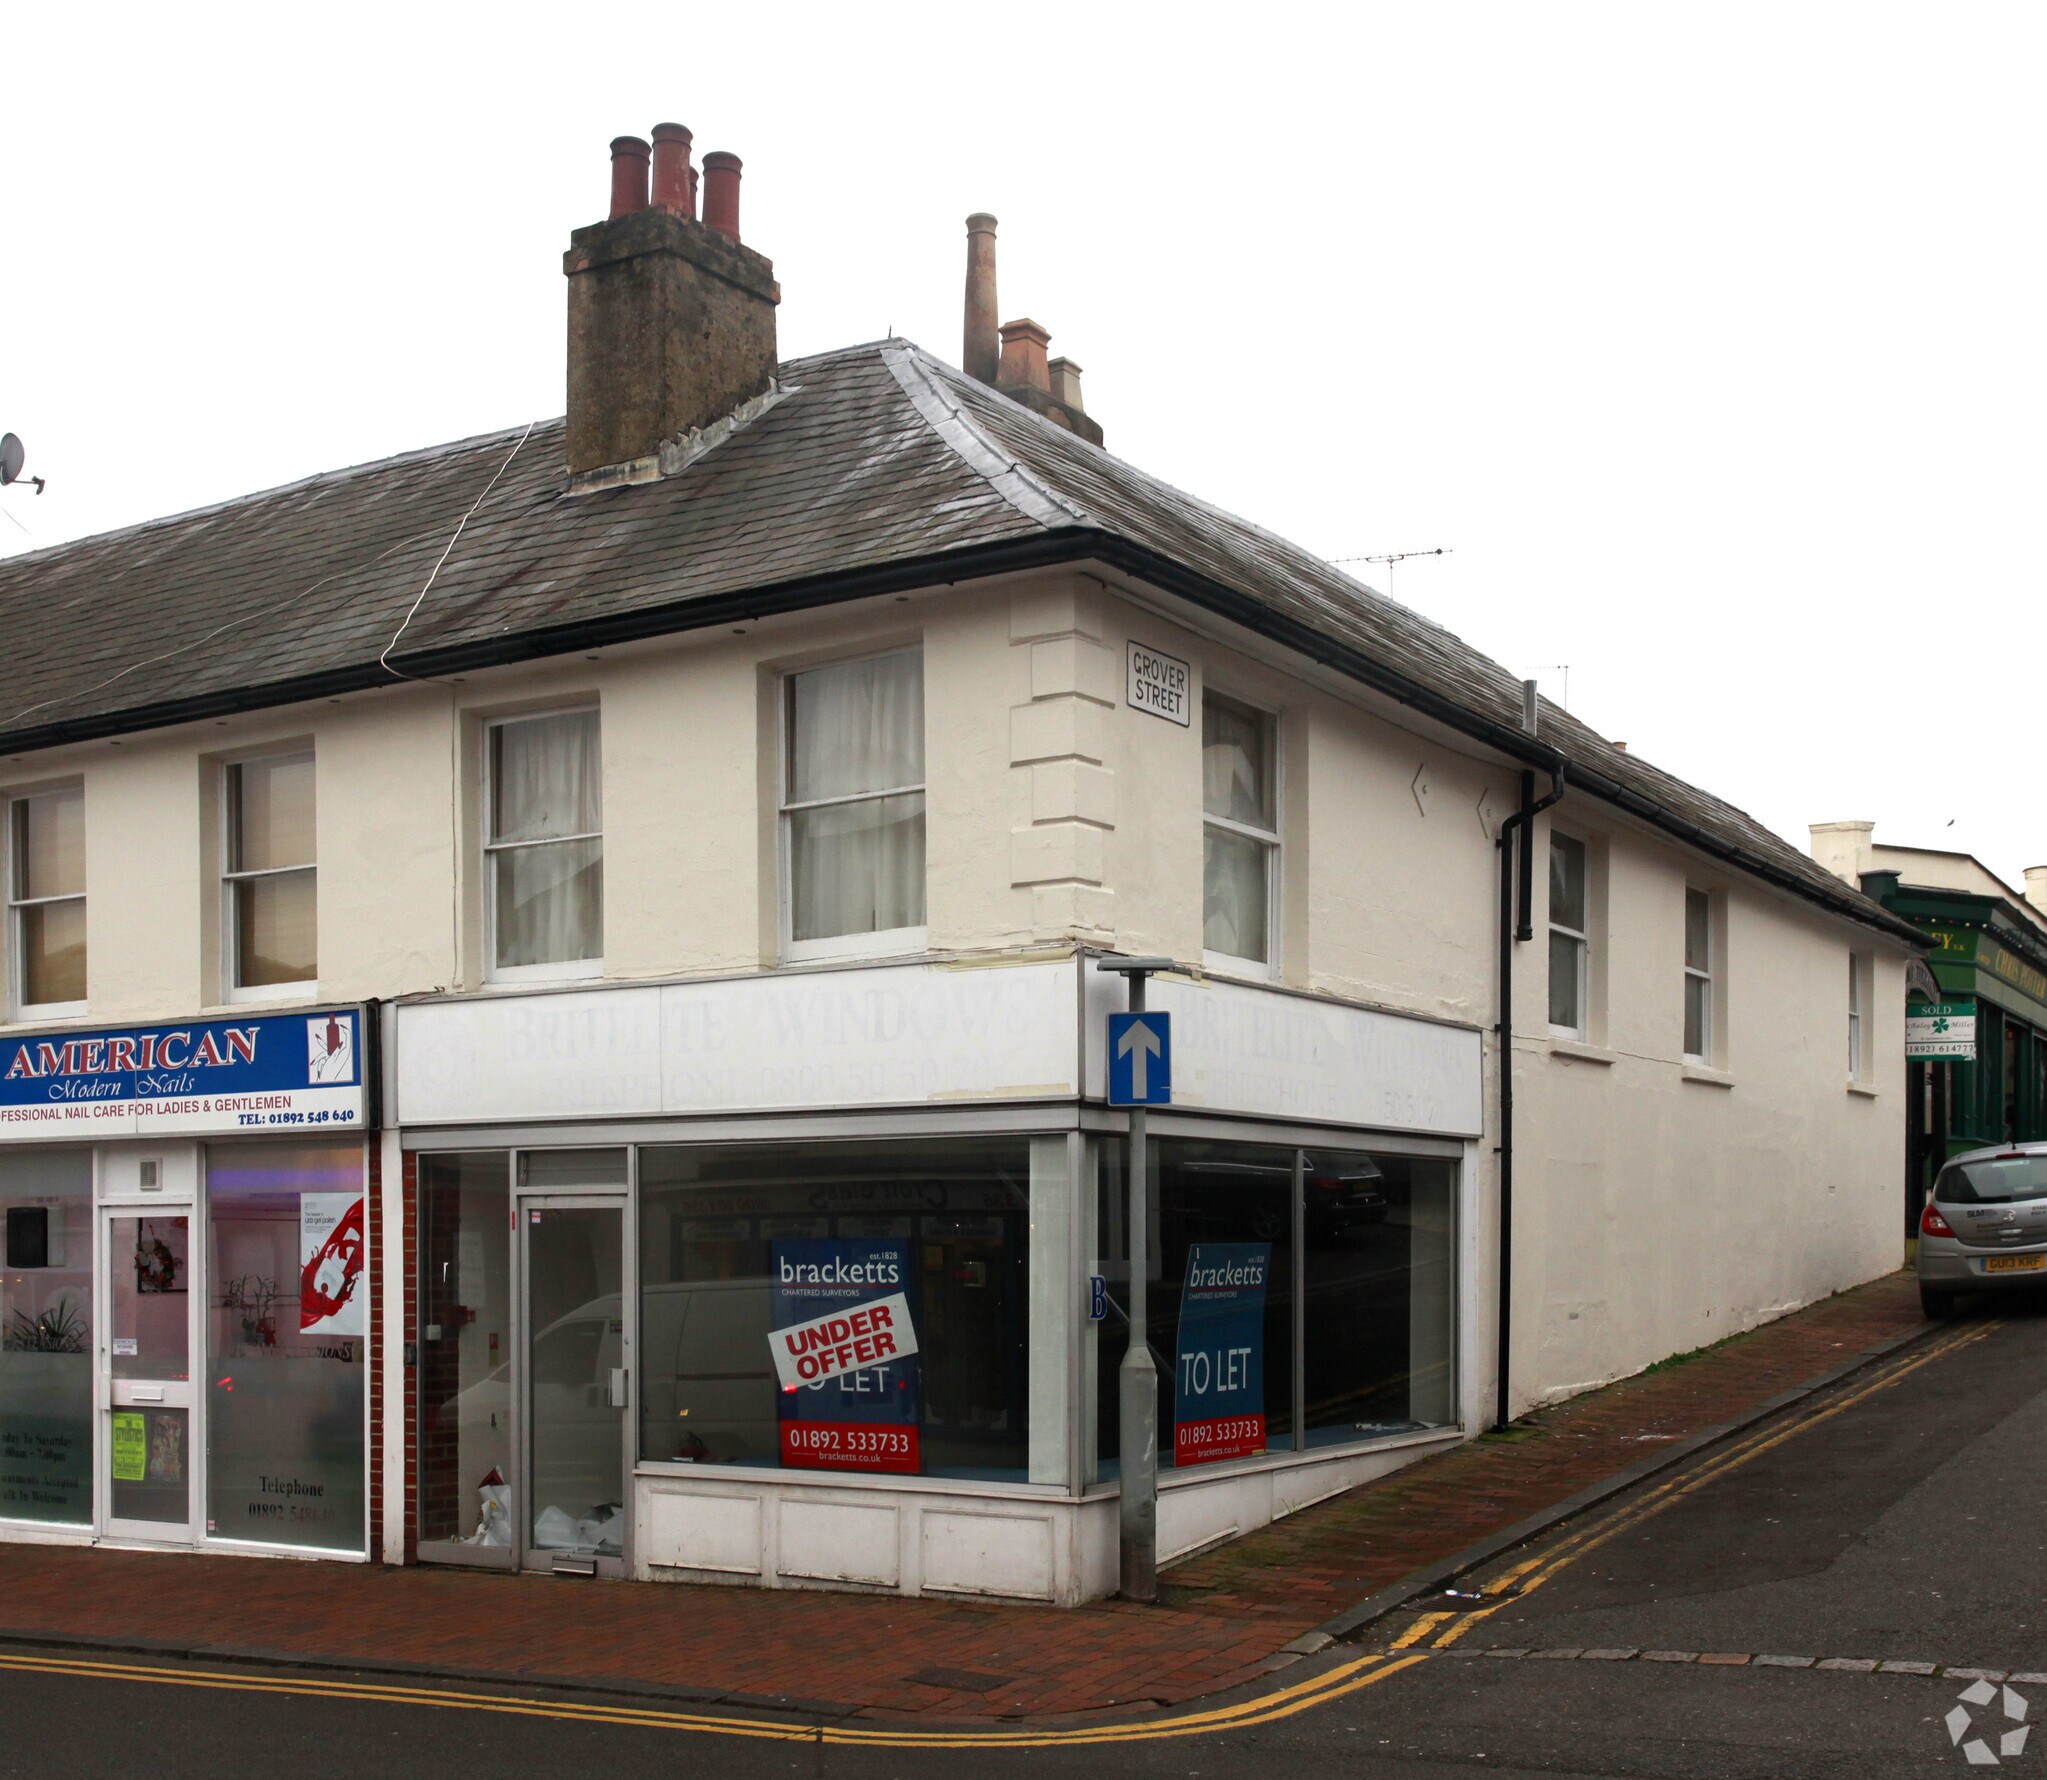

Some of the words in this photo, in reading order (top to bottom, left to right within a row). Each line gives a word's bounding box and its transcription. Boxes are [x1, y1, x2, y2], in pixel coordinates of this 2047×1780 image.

[1133, 651, 1185, 692] GROVER
[1135, 678, 1182, 715] STREET
[1921, 1005, 1952, 1015] SOLD
[3, 1026, 261, 1080] AMERICAN
[1938, 1044, 1974, 1053] 614777
[49, 1079, 122, 1100] Modern
[136, 1072, 195, 1095] Nails
[0, 1108, 62, 1122] FESSIONAL
[65, 1106, 90, 1119] NAIL
[93, 1104, 125, 1118] CARE
[128, 1103, 153, 1116] FOR
[157, 1100, 200, 1115] LADIES
[203, 1099, 211, 1112] &
[215, 1095, 292, 1112] GENTLEMEN
[238, 1113, 266, 1126] TEL:
[269, 1112, 305, 1124] 01892
[307, 1110, 330, 1123] 548
[332, 1109, 354, 1121] 640
[780, 1255, 900, 1285] bracketts
[869, 1252, 898, 1261] est.1828
[1189, 1259, 1264, 1288] bracketts
[781, 1288, 821, 1297] CHARTERED
[821, 1288, 860, 1298] SURVEYORS
[1089, 1274, 1108, 1320] B
[784, 1304, 894, 1357] UNDER
[796, 1331, 898, 1381] OFFER
[839, 1366, 890, 1393] LET
[1181, 1351, 1211, 1396] TO
[1216, 1346, 1252, 1392] LET
[36, 1433, 72, 1450] Saturday
[790, 1429, 841, 1450] 01892
[847, 1432, 909, 1453] 533733
[1180, 1424, 1213, 1446] 01892
[1216, 1419, 1259, 1441] 533733
[818, 1450, 881, 1463] bracketts.co.uk
[1197, 1444, 1240, 1459] bracketts.co.uk
[258, 1475, 325, 1498] Telephone
[248, 1502, 284, 1520] 01892
